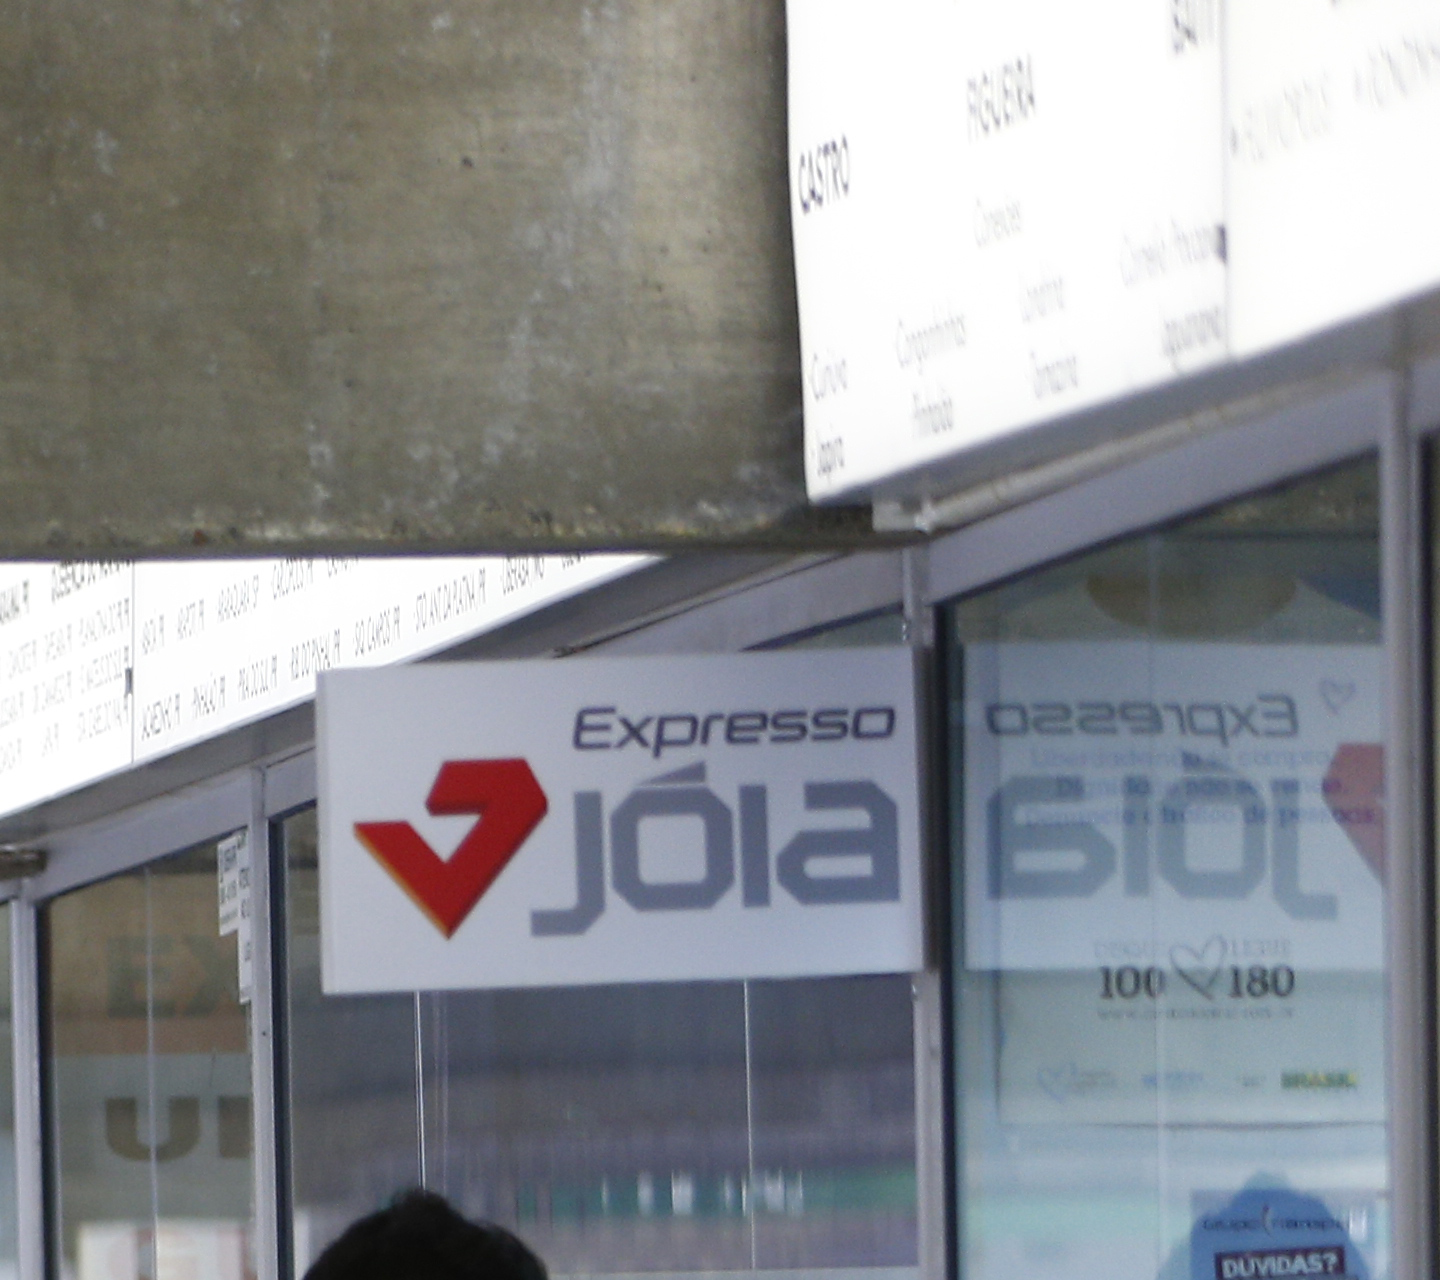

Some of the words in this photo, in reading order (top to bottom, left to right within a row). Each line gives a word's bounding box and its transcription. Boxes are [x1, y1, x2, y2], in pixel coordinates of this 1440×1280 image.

[798, 135, 851, 215] CASTRO
[573, 706, 896, 759] Expresso
[1099, 965, 1167, 1000] 100
[1228, 964, 1296, 999] 180
